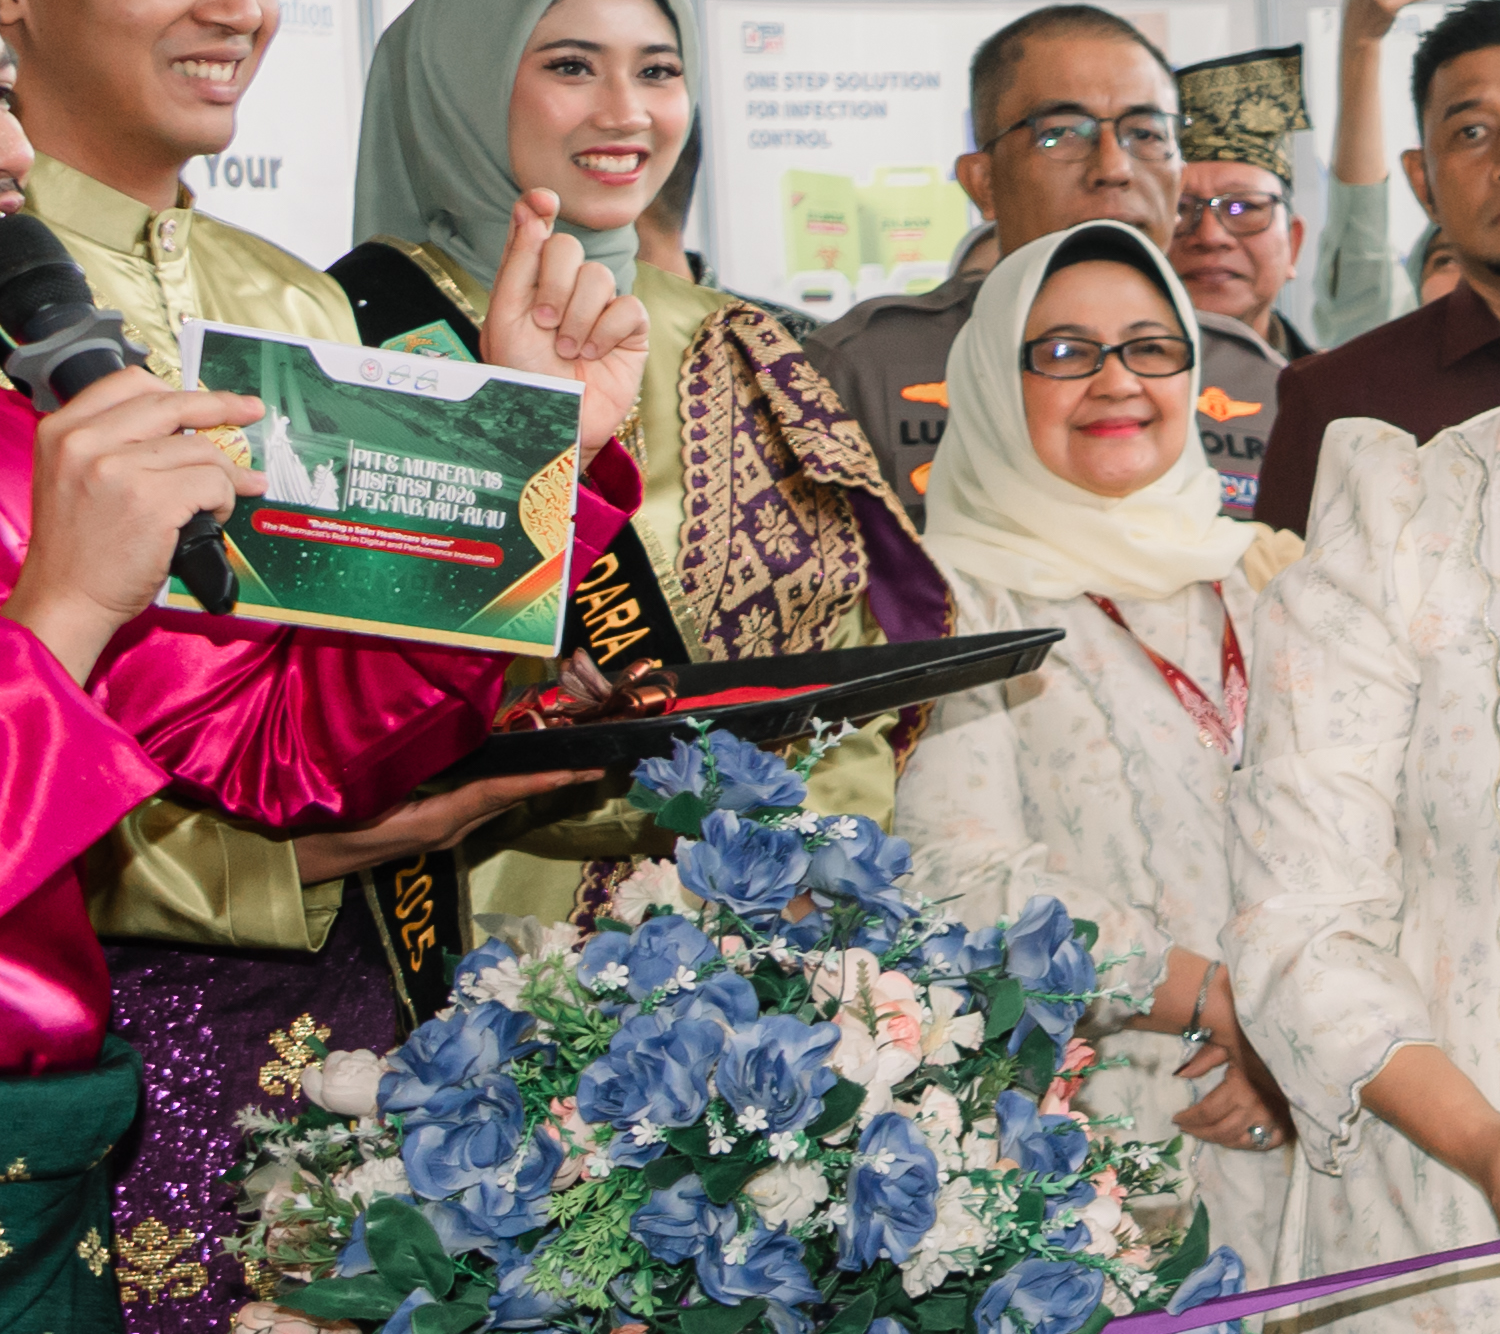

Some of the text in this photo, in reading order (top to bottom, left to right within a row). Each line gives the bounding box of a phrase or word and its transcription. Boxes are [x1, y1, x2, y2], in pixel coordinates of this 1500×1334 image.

[744, 71, 941, 91] ONE STEP SOLUTION
[746, 100, 887, 119] FOR INFECTION
[748, 129, 832, 148] CONTROL
[204, 154, 283, 190] Your
[1199, 430, 1265, 460] OLR
[403, 457, 504, 491] MUKERNAS
[348, 487, 507, 530] PEKANBARU-RIAU
[435, 483, 477, 506] 2026
[576, 552, 651, 666] DARA
